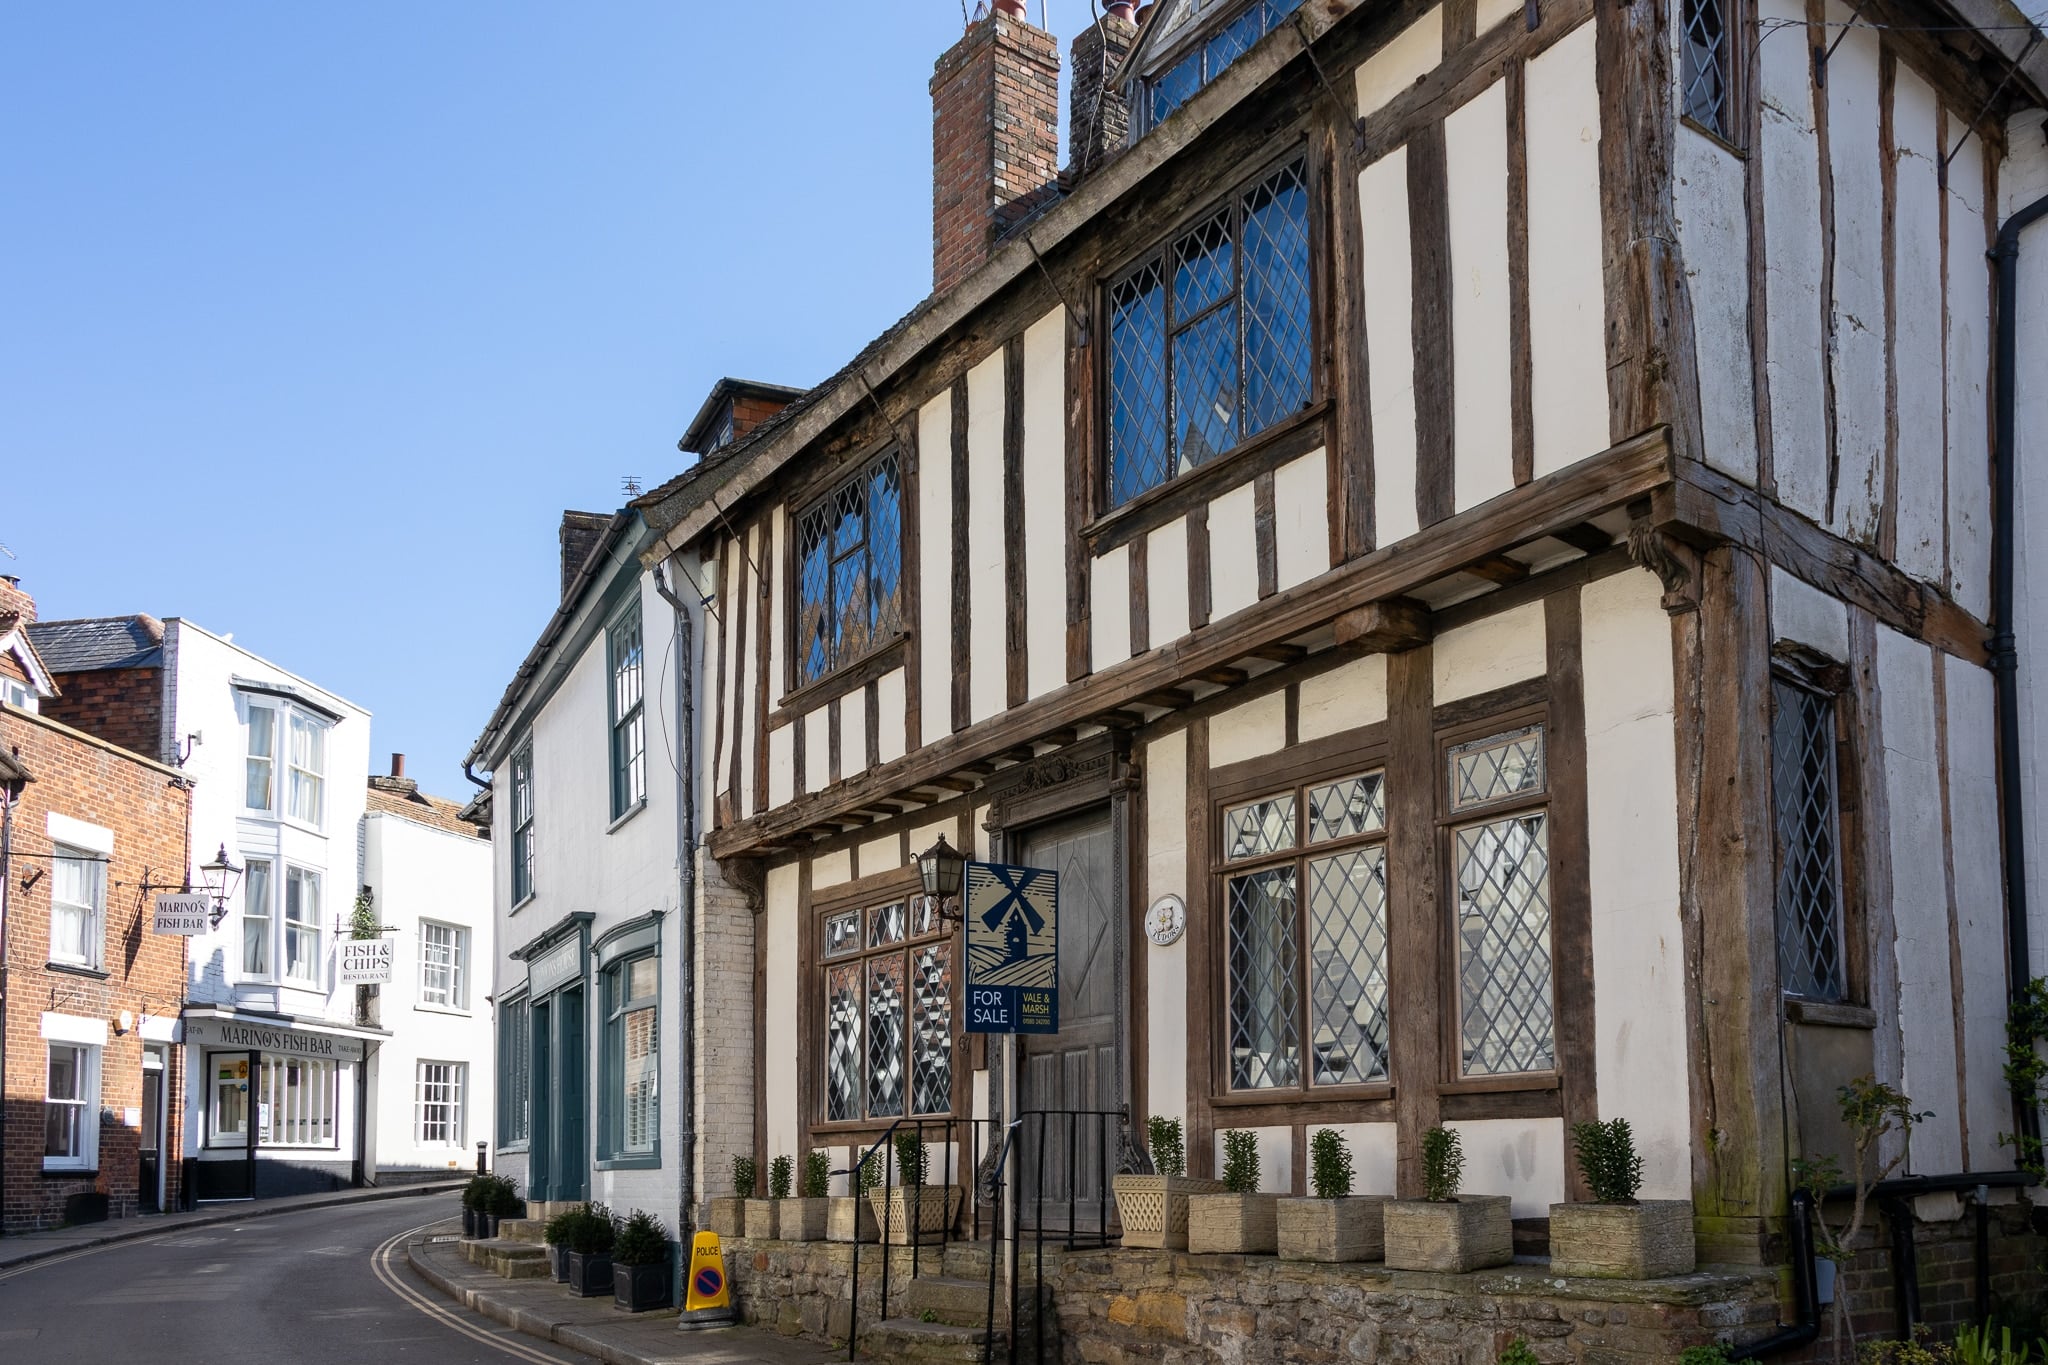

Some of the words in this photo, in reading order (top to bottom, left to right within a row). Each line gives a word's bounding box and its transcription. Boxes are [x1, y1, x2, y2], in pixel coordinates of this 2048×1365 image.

[158, 900, 206, 913] MARINO'S
[157, 918, 180, 929] FISH
[183, 918, 204, 929] BAR
[1153, 925, 1179, 941] TUDORS
[345, 945, 376, 957] FISH
[380, 944, 390, 956] &
[343, 957, 390, 970] CHIPS
[343, 972, 389, 981] RESTAURANT
[973, 991, 1002, 1006] FOR
[1022, 993, 1042, 1003] VALE
[1044, 993, 1050, 1003] &
[1022, 1004, 1049, 1014] MARSH
[974, 1008, 1009, 1024] SALE
[220, 1026, 280, 1049] MARINO'S
[283, 1034, 308, 1052] FISH
[310, 1038, 332, 1055] BAR
[696, 1246, 718, 1256] POLICE
